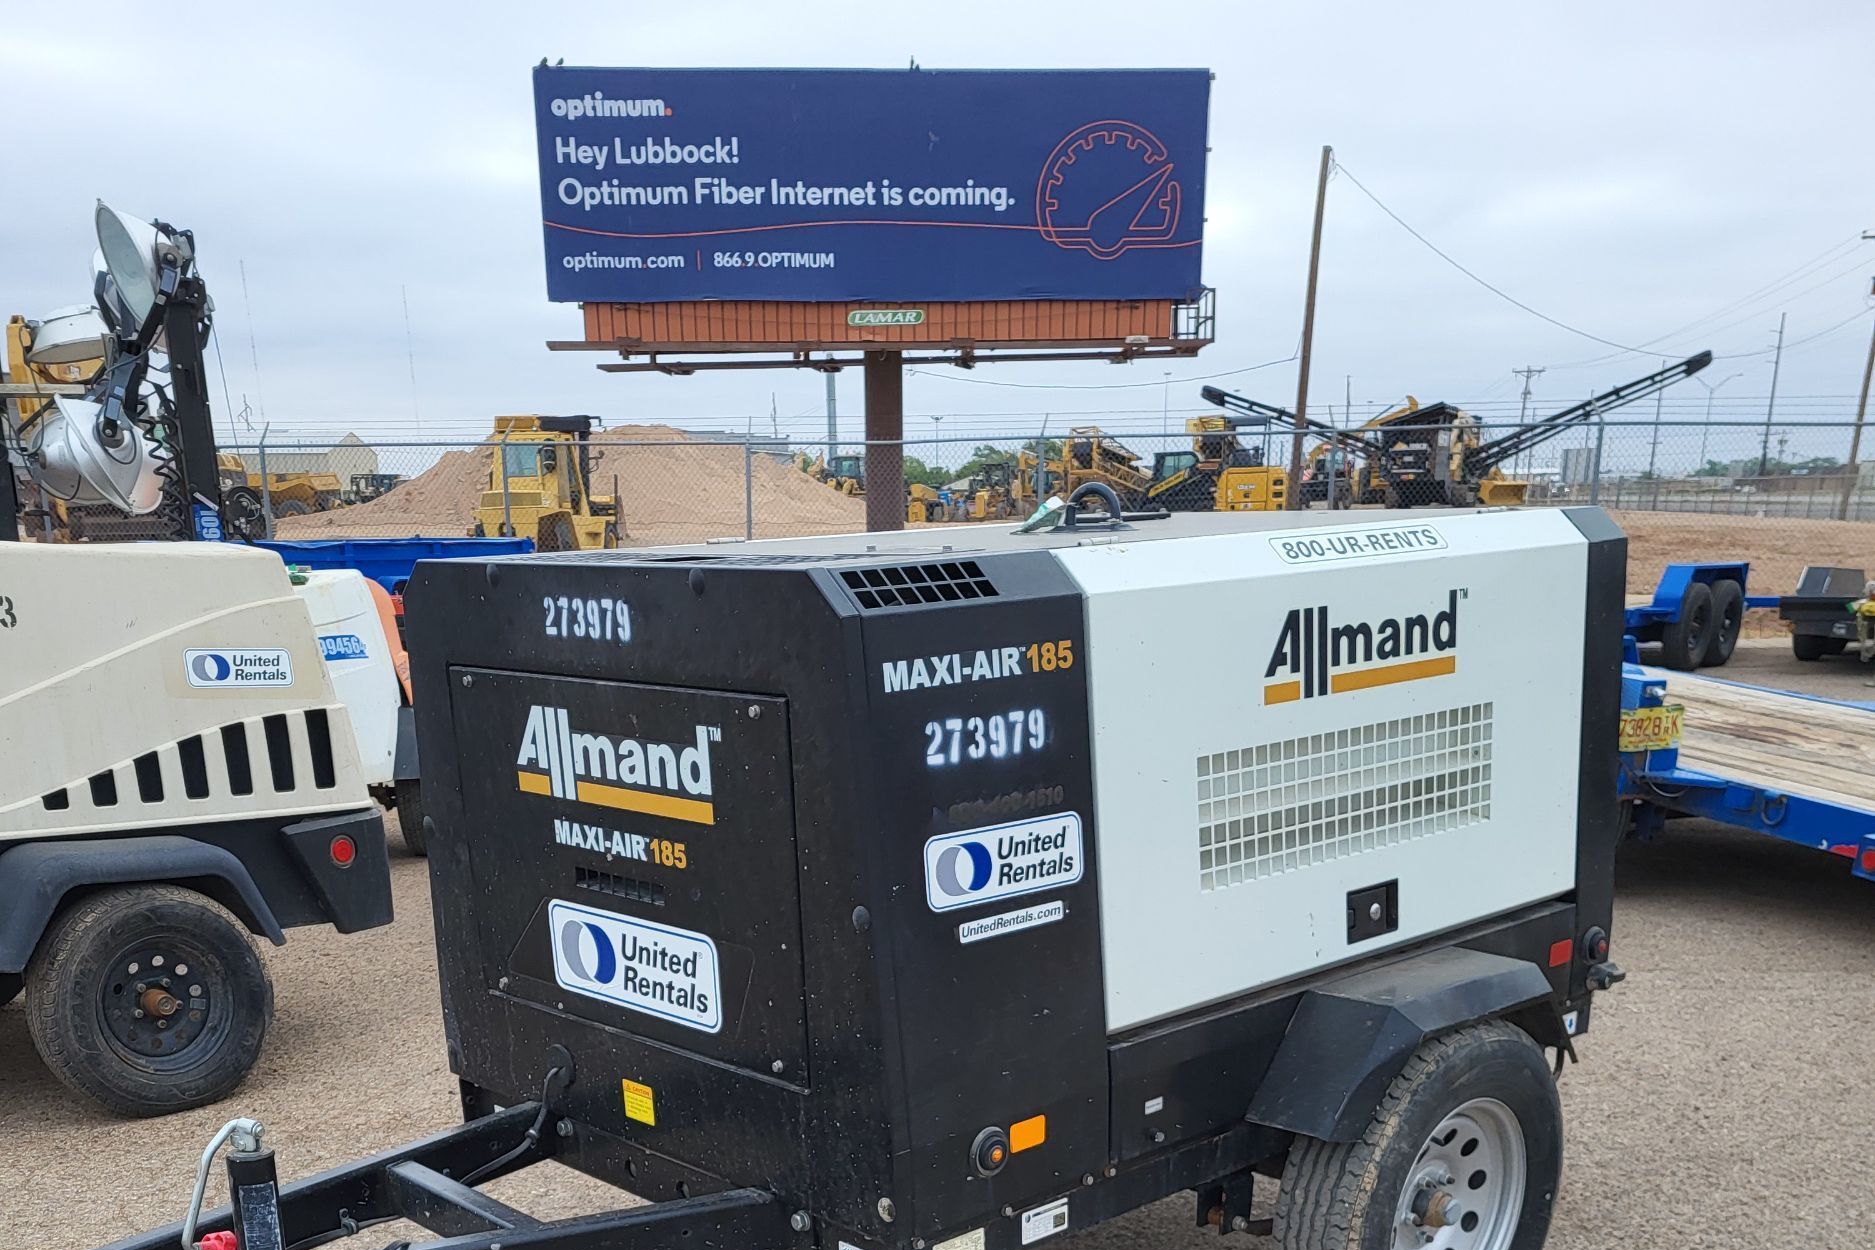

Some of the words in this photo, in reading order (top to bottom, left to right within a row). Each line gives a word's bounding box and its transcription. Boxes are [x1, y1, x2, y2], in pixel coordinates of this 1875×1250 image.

[551, 91, 672, 120] optimum.
[555, 136, 608, 170] Hey
[614, 136, 739, 164] Lubbock!
[558, 177, 688, 211] Optimum
[694, 177, 765, 204] Fiber
[771, 178, 877, 205] Internet
[882, 179, 903, 205] is
[908, 179, 1015, 211] coming.
[562, 252, 684, 271] optimum.com
[713, 252, 835, 268] 866.9.OPTIMUM
[854, 312, 917, 323] LAMAR
[1281, 528, 1438, 560] 800-UR-RENTS
[543, 596, 631, 642] 273979
[233, 655, 280, 667] United
[235, 669, 287, 681] Rentals
[882, 647, 1023, 693] MAXI-AIR
[1027, 640, 1073, 672] 185
[925, 709, 1046, 766] 273979
[554, 819, 648, 862] MAXI-AIR
[650, 838, 687, 869] 185
[997, 826, 1067, 860] United
[998, 852, 1074, 886] Rentals
[961, 906, 1061, 938] UnitedRentals.com
[621, 933, 698, 979] United
[624, 965, 708, 1013] Rentals
